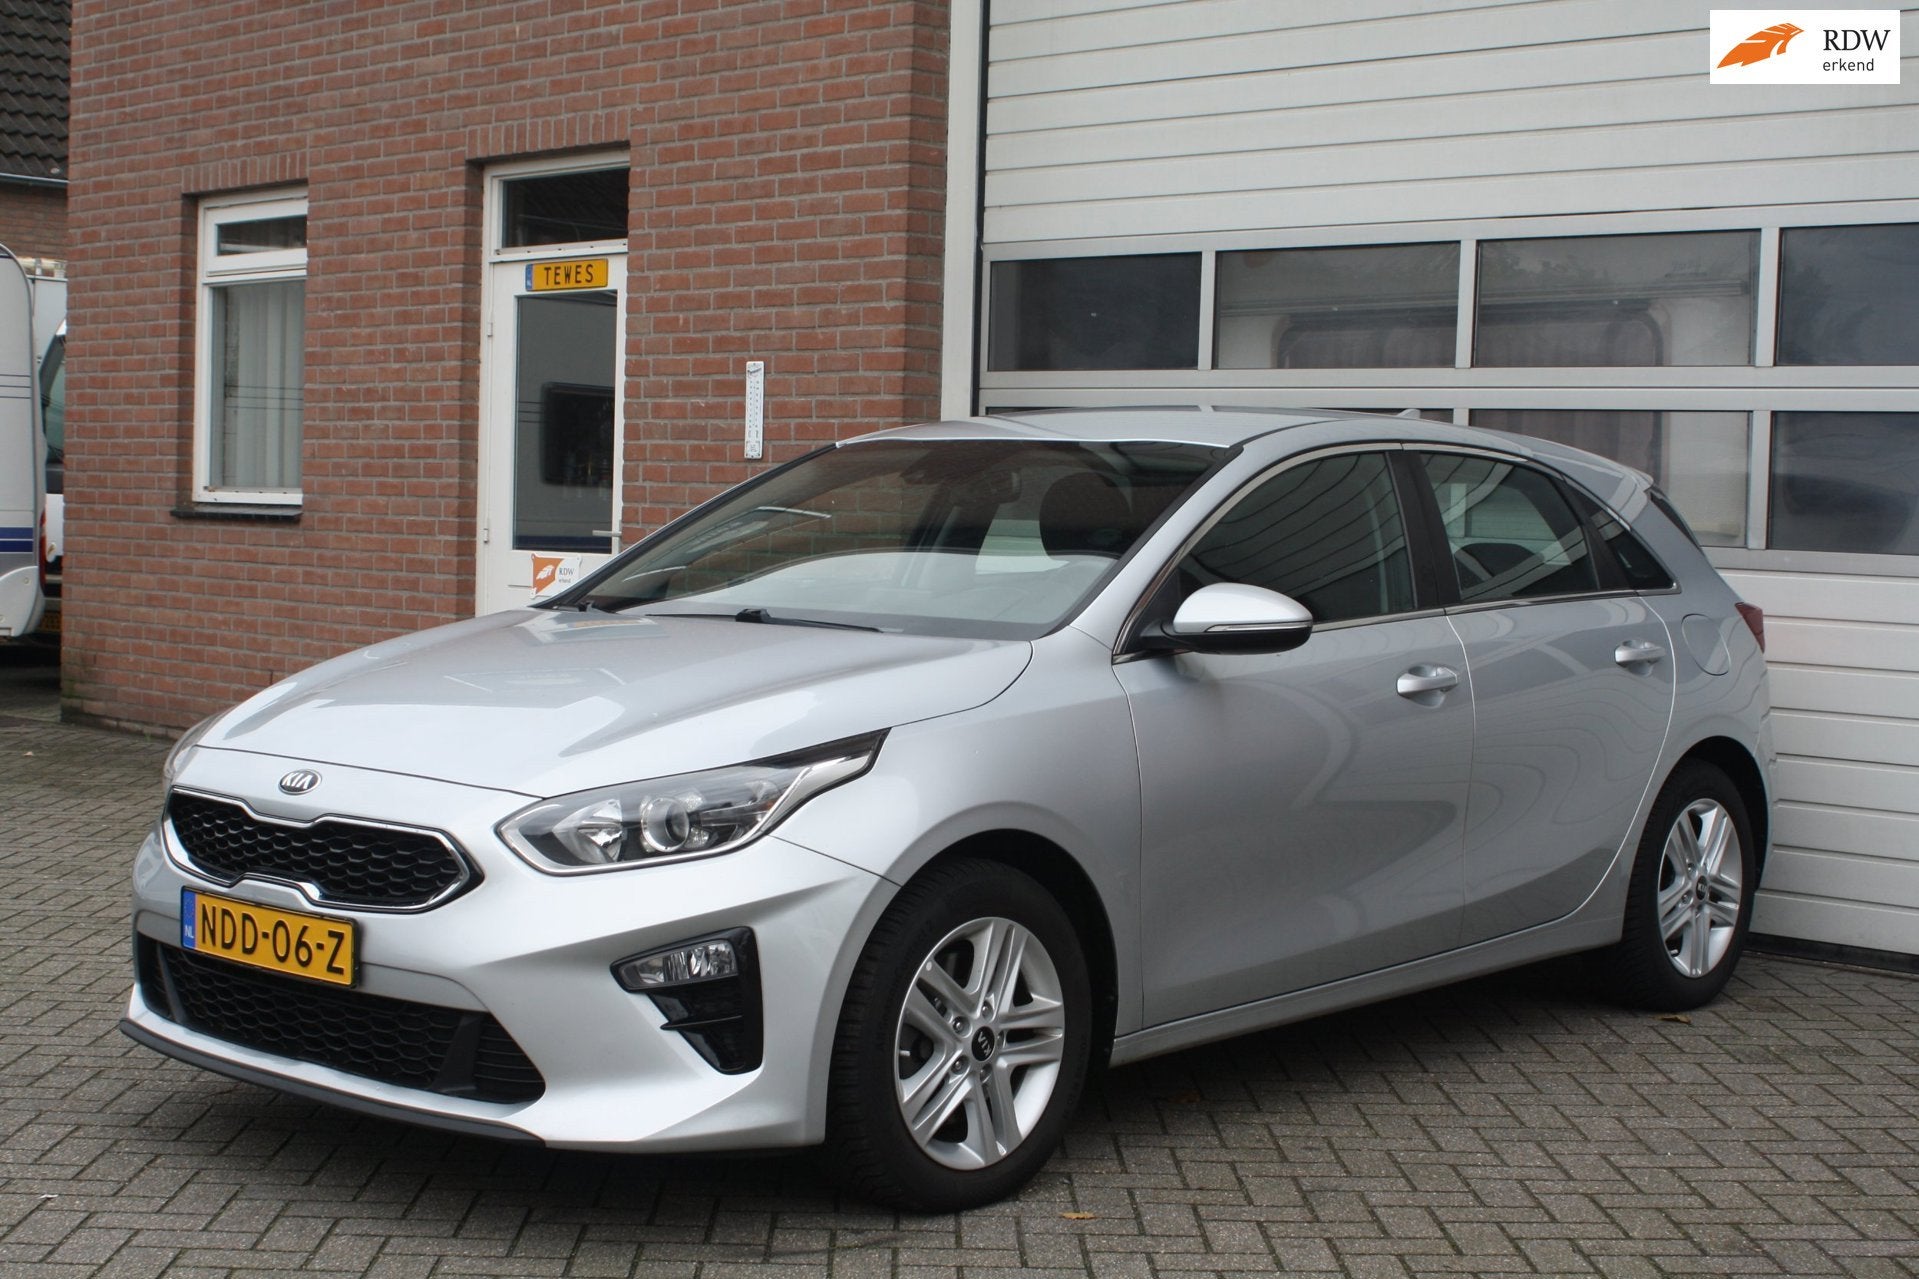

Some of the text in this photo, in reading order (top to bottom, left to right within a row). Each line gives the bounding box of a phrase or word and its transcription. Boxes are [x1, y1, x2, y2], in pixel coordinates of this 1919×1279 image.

[544, 263, 594, 286] TEWES
[281, 772, 313, 790] KIA
[184, 925, 195, 939] NL
[202, 903, 345, 976] NDD-06-Z
